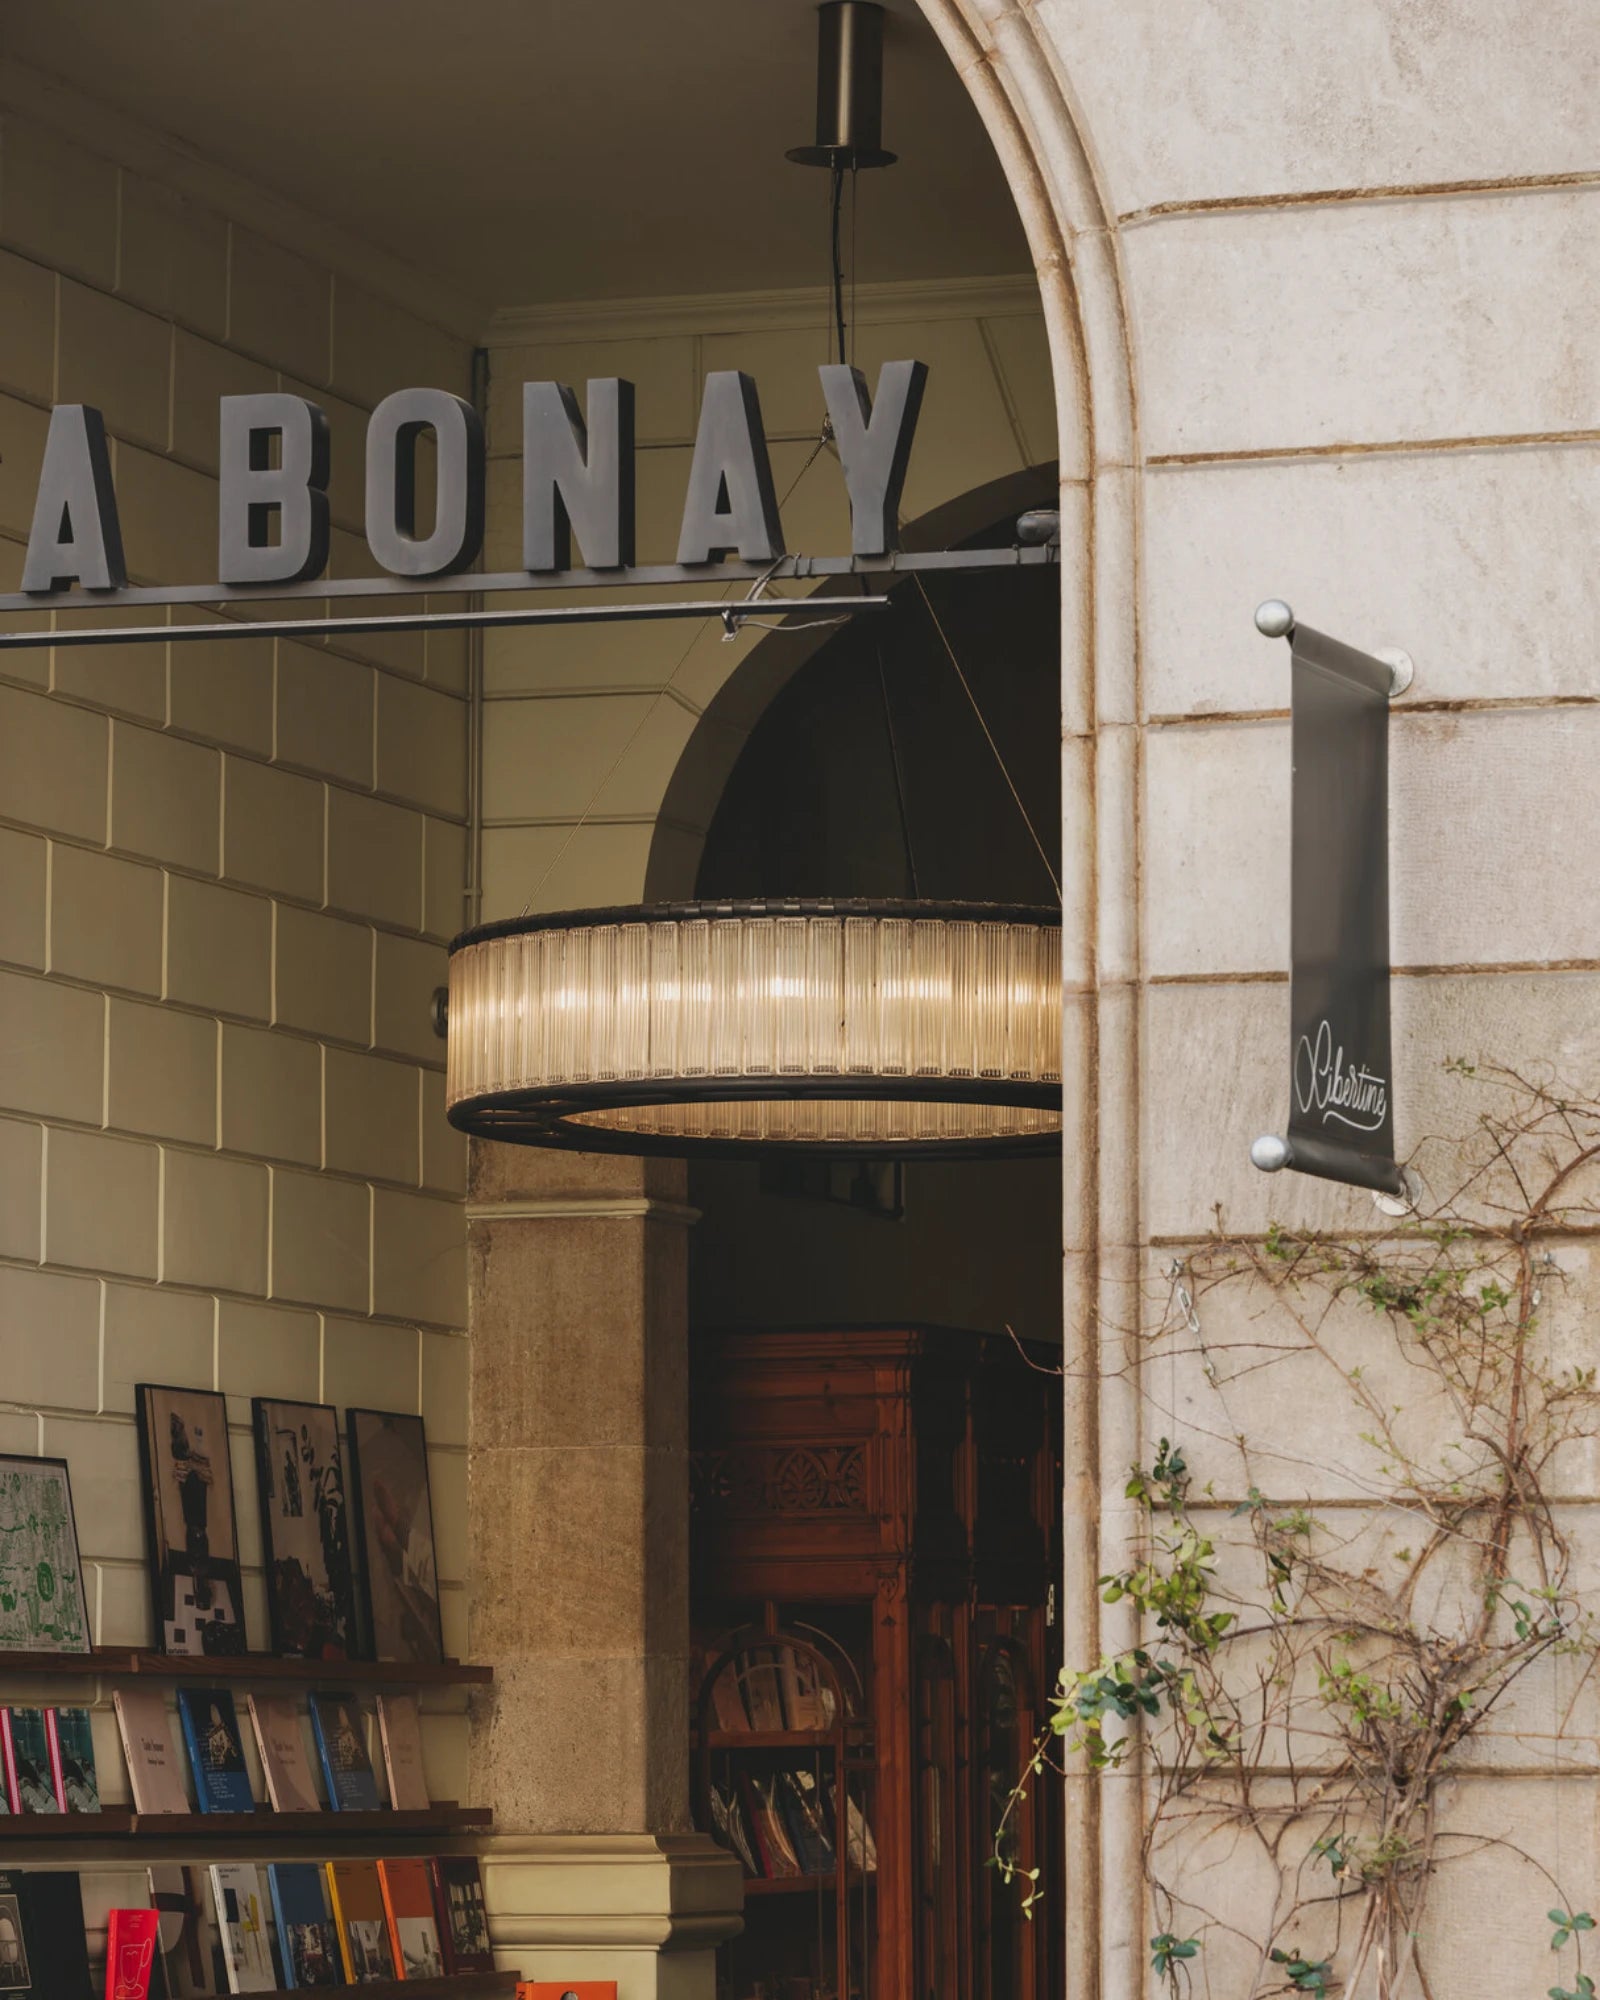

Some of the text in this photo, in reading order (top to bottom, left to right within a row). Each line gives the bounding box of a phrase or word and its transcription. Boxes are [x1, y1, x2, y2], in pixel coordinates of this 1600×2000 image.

[0, 360, 928, 592] A BONAY
[1294, 1020, 1386, 1131] Libertine
